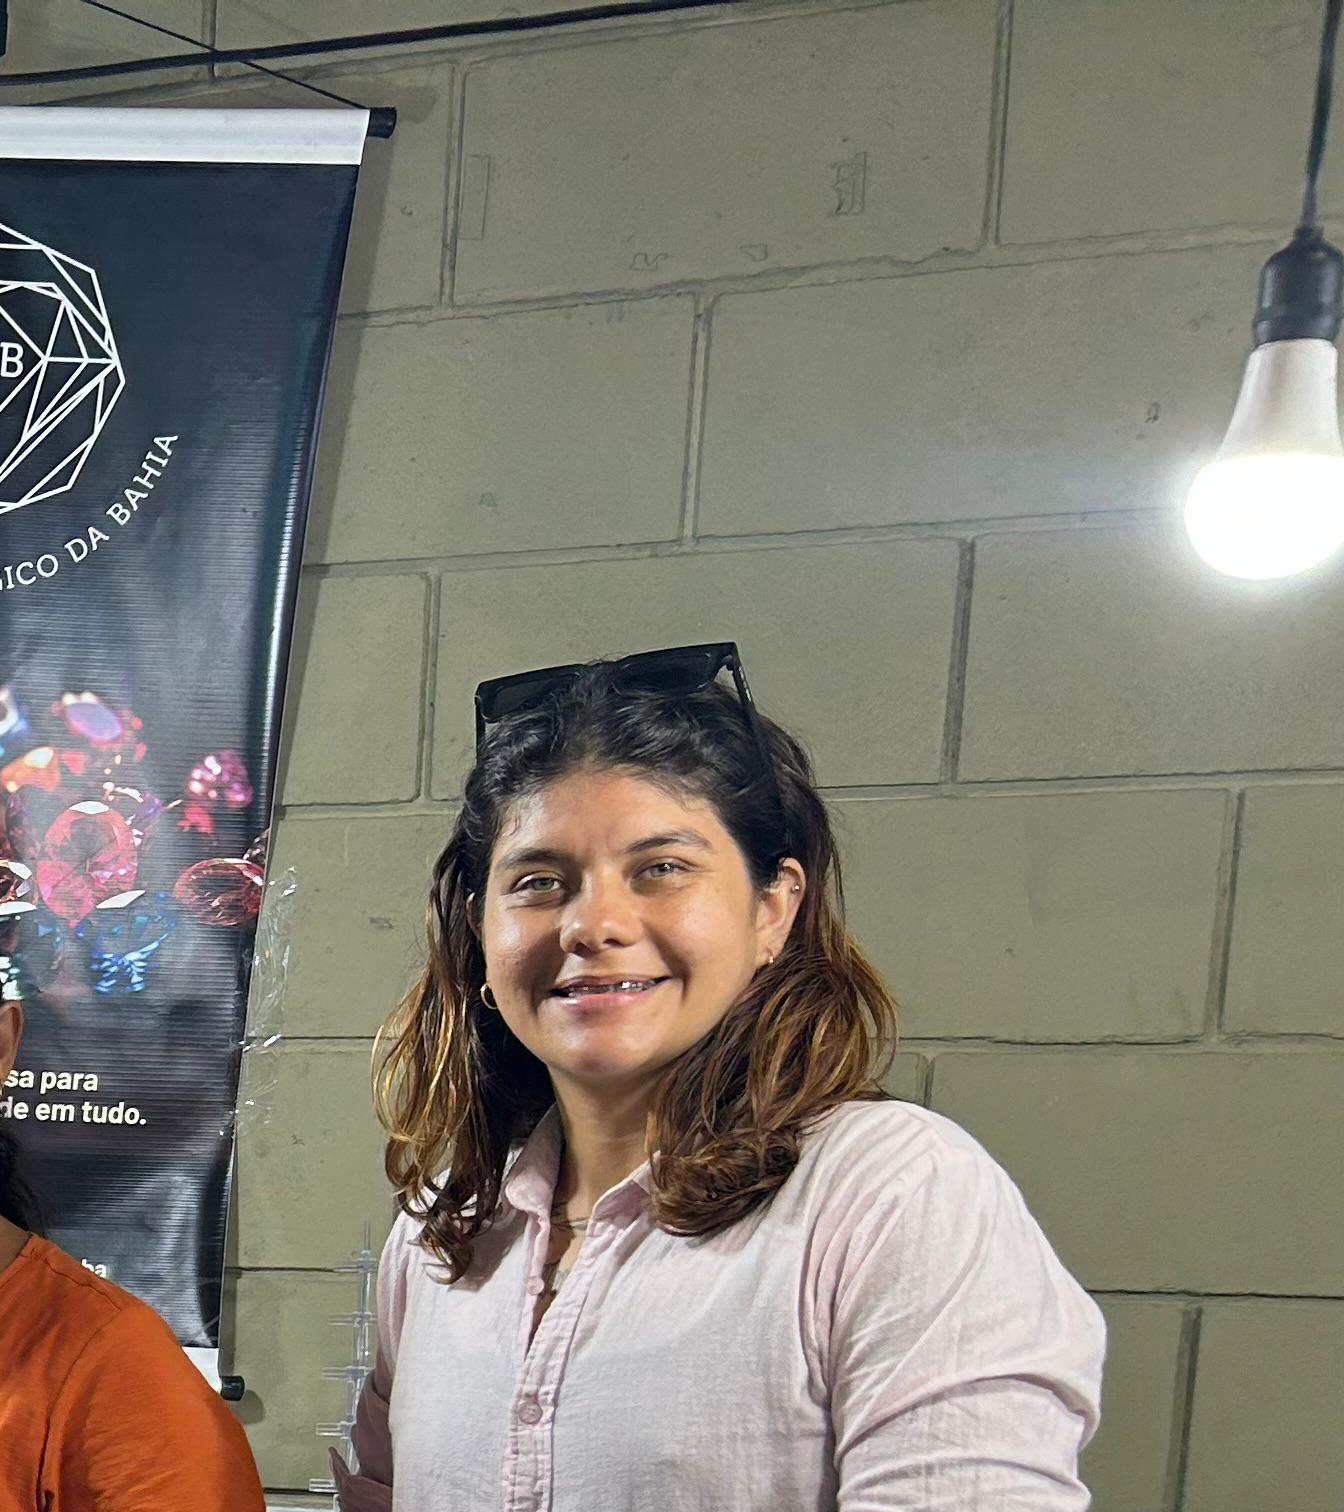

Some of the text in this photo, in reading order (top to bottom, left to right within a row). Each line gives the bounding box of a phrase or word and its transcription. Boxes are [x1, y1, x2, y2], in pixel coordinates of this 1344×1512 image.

[63, 525, 110, 563] DA
[105, 435, 179, 526] BAHIA
[3, 1069, 35, 1089] sa
[39, 1070, 99, 1095] para
[34, 1101, 75, 1122] em
[81, 1101, 147, 1126] tudo.
